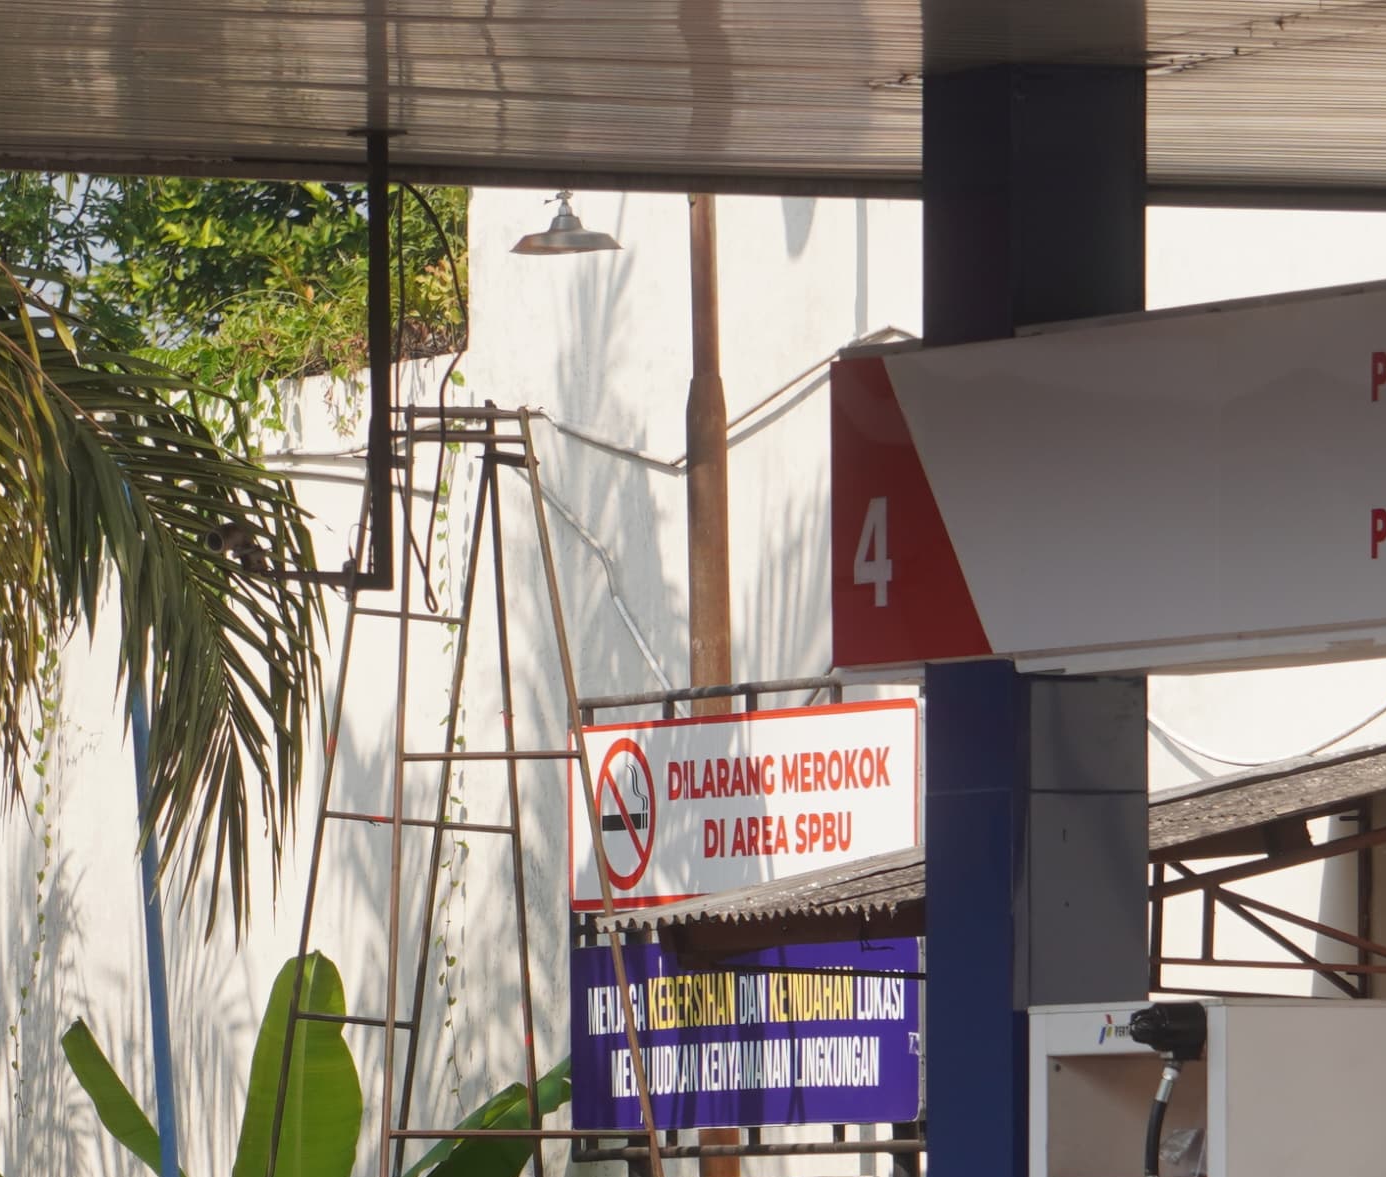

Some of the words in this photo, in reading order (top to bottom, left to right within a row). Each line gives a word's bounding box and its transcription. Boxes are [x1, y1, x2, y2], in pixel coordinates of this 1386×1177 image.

[853, 495, 892, 608] 4
[668, 755, 775, 801] DILARANG
[781, 746, 891, 793] MEROKOK
[704, 819, 724, 858] DI
[731, 815, 789, 857] AREA
[795, 811, 852, 854] SPBU
[648, 972, 735, 1031] KEBERSIHAN
[739, 974, 766, 1026] DAN
[768, 966, 854, 1023] KEINDAHAN
[856, 969, 905, 1021] LOKASI
[702, 1040, 791, 1092] KENYAMANAN
[794, 1035, 880, 1088] LINGKUNGAN
